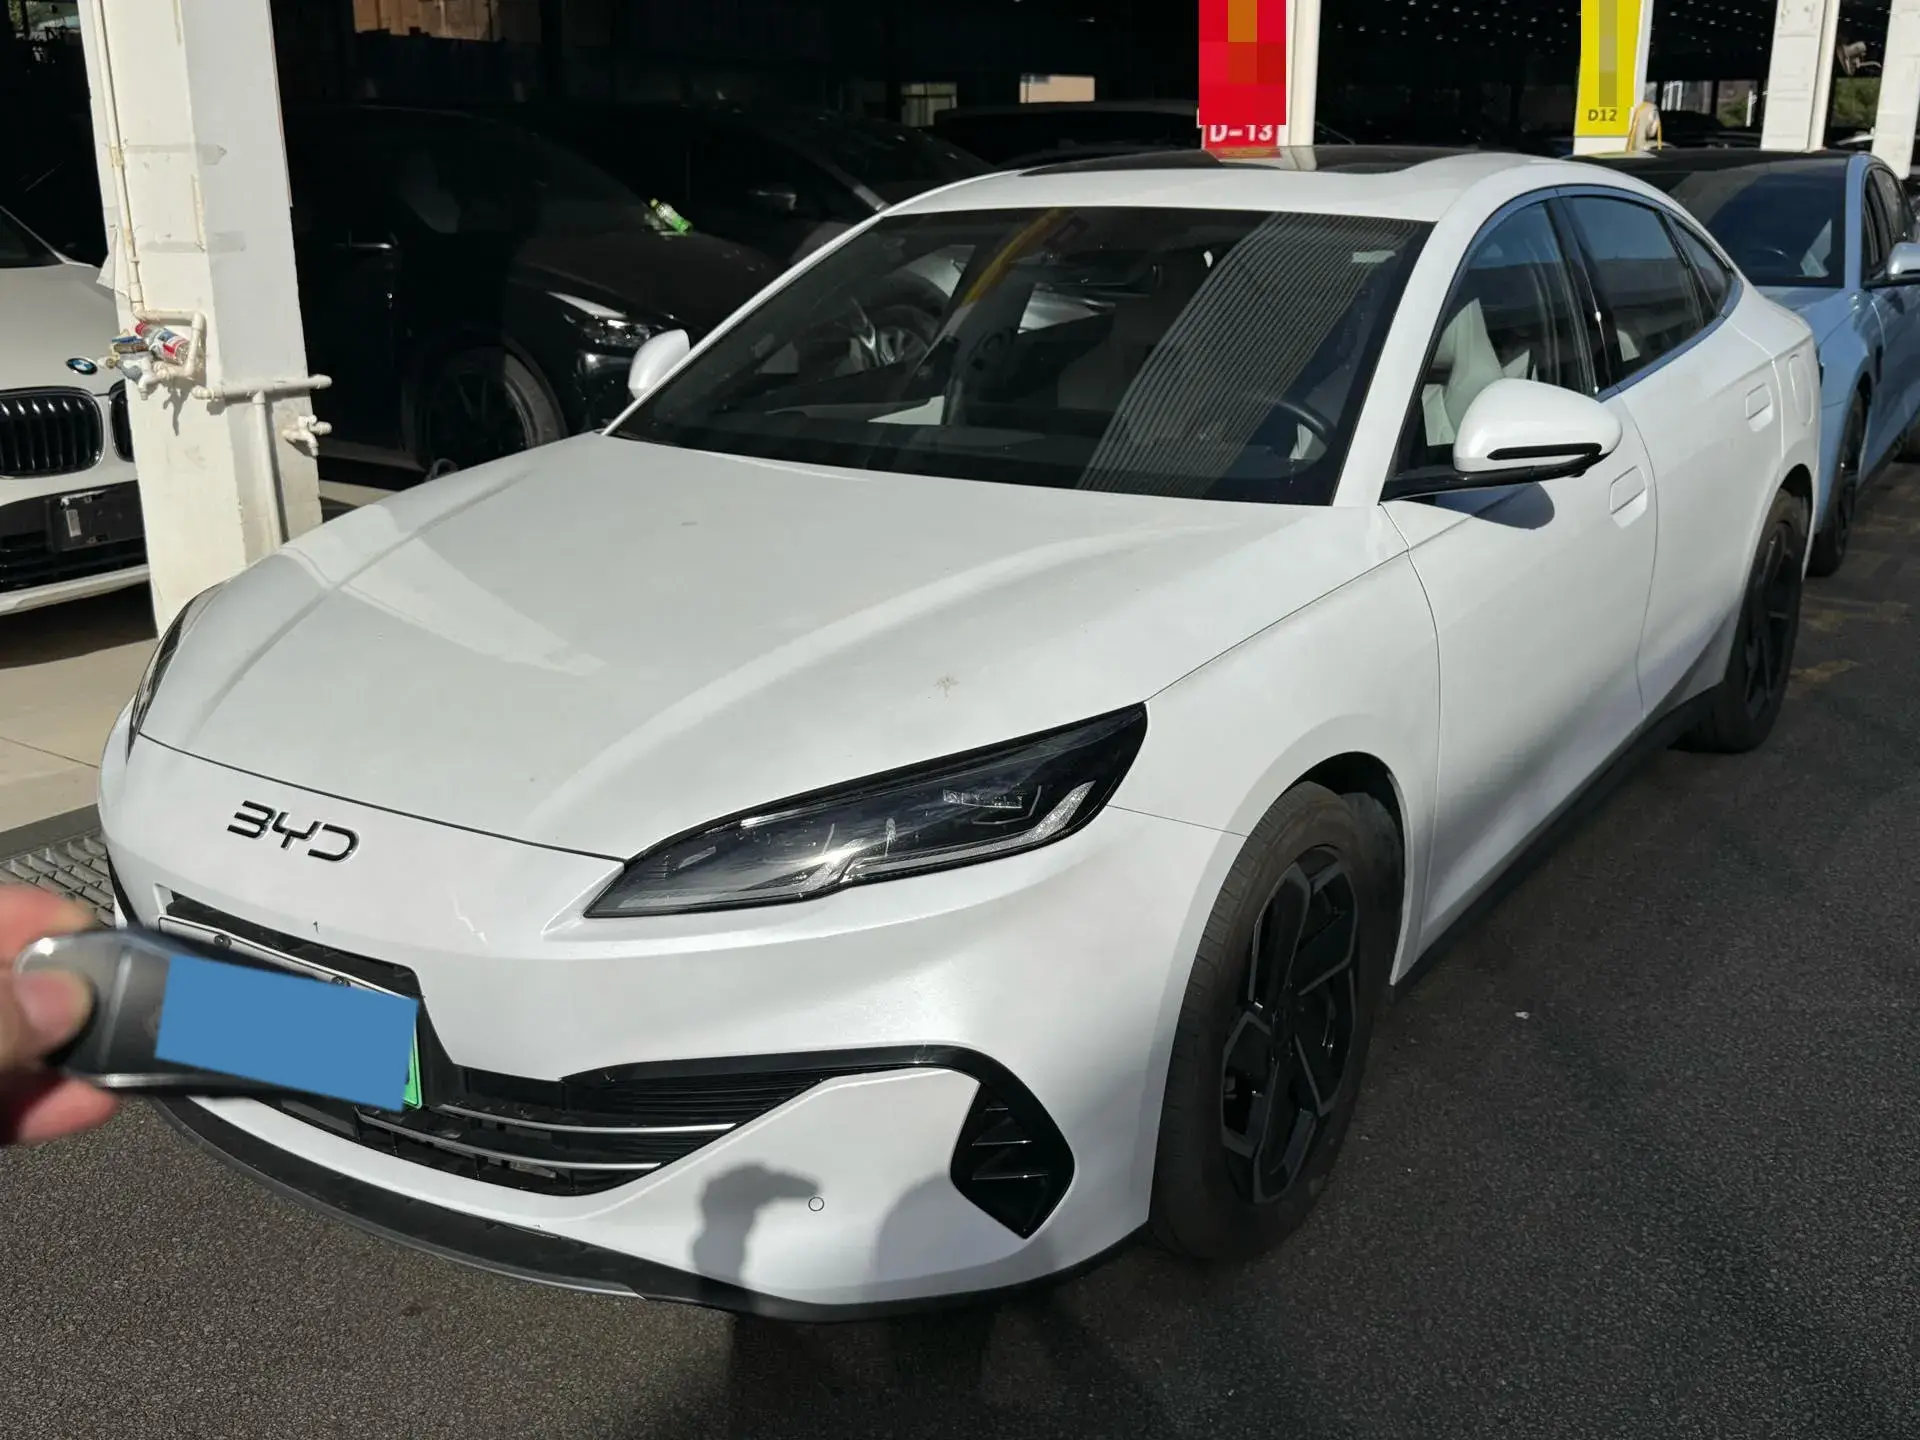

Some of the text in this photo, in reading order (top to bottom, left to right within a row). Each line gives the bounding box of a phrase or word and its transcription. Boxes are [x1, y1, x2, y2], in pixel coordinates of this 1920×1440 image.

[1588, 109, 1617, 122] D12
[1209, 124, 1273, 142] D-13
[227, 800, 360, 863] BYD
